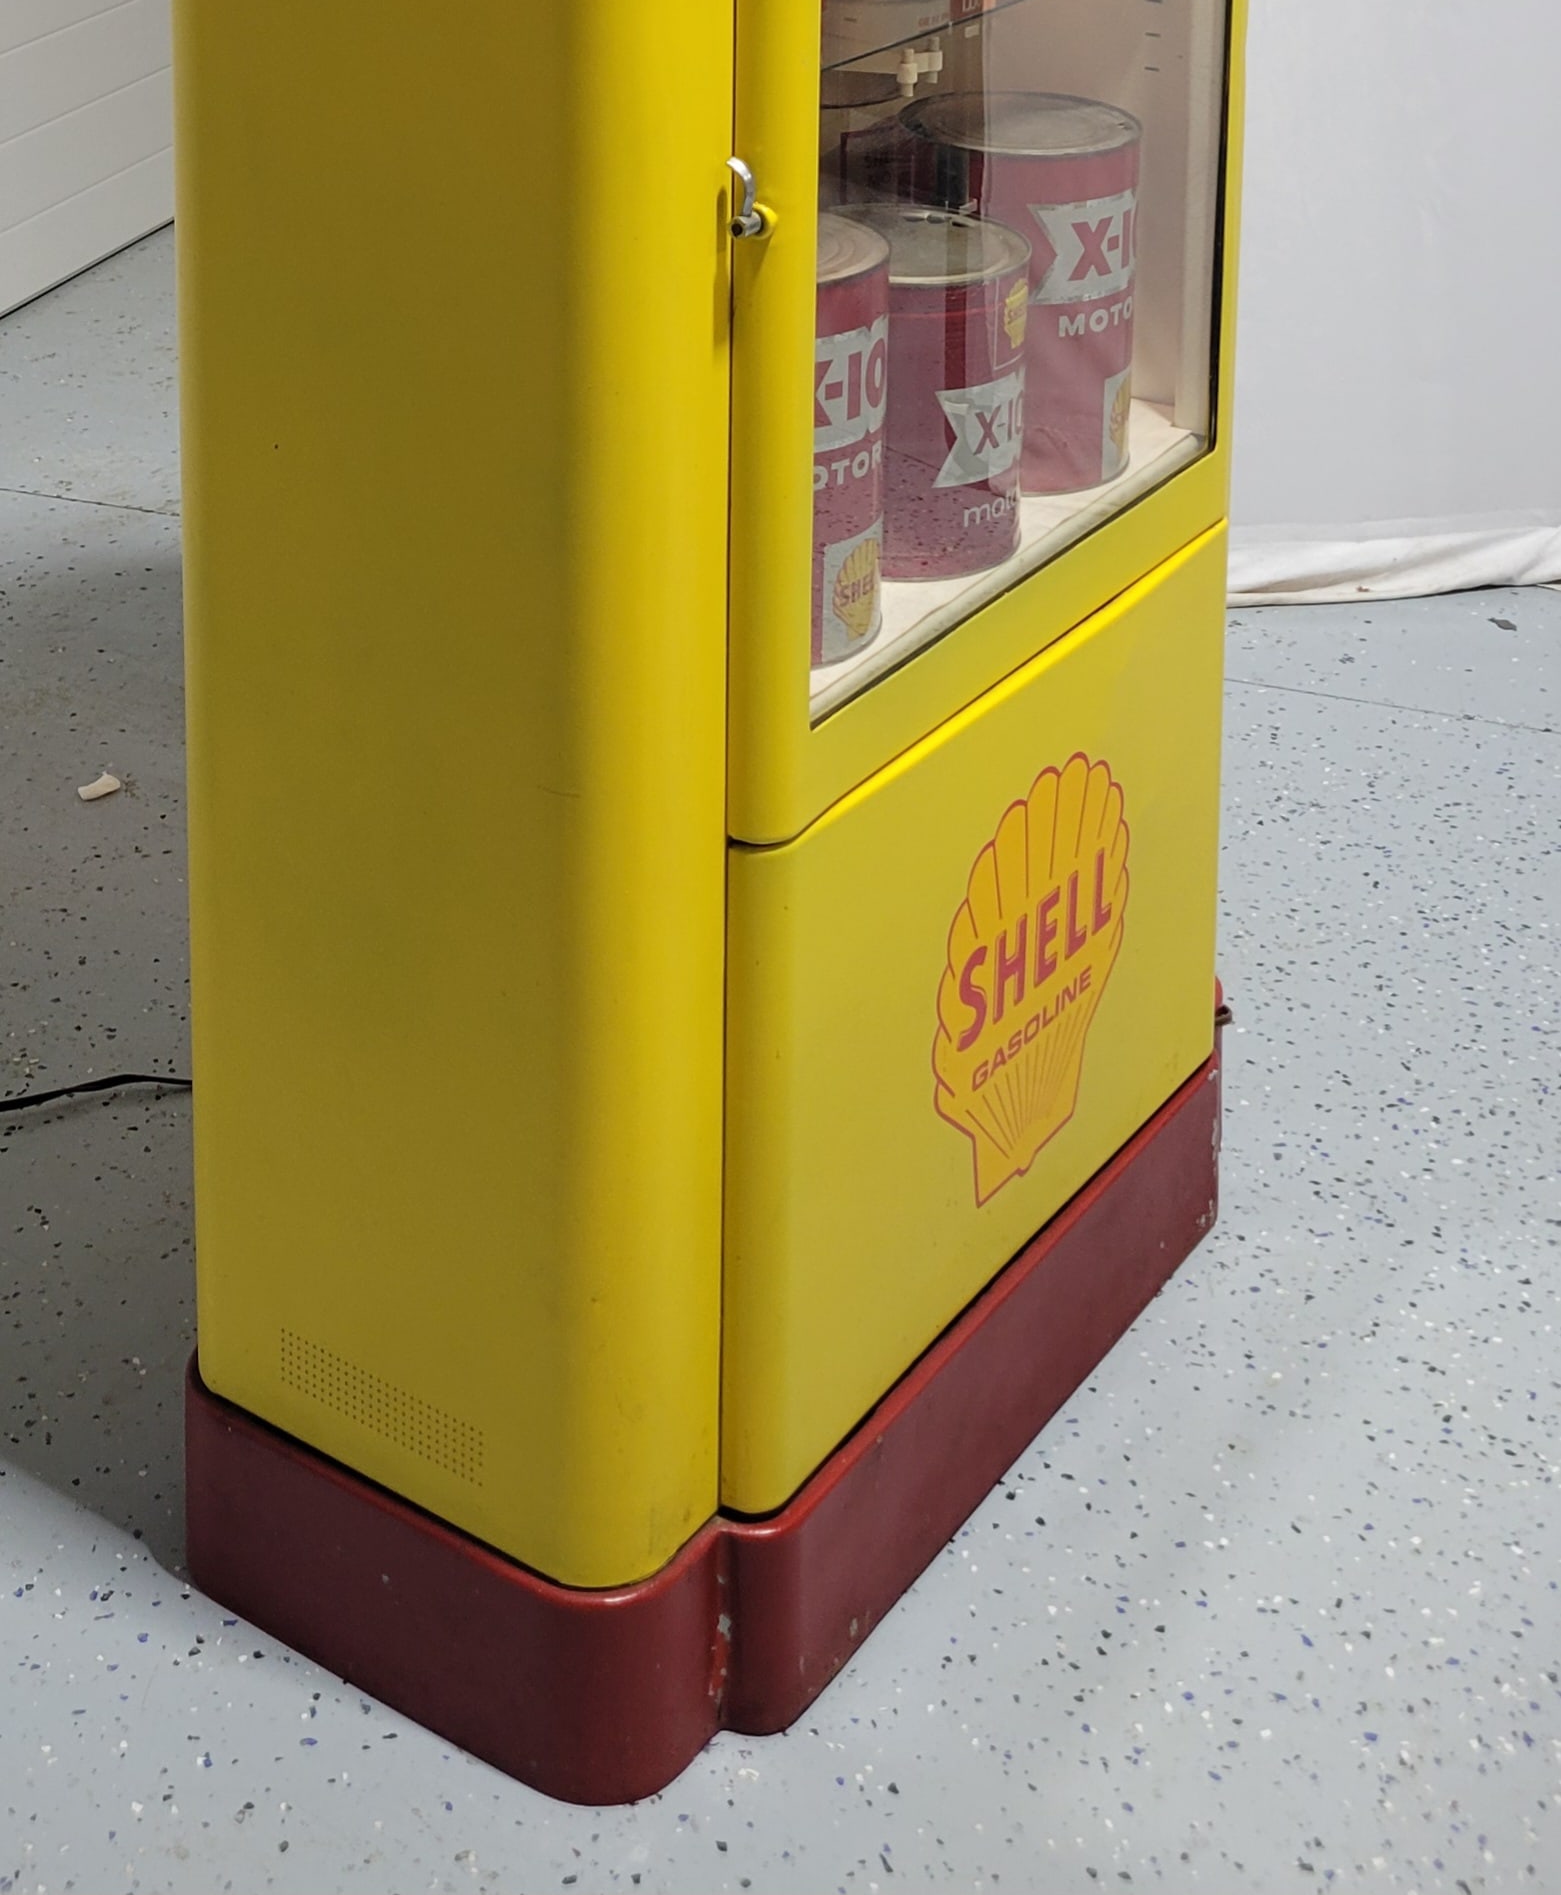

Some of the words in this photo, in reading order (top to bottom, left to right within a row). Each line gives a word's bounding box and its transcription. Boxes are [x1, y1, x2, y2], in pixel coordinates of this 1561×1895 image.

[1067, 208, 1136, 281] X-1
[1058, 295, 1133, 337] MOTO
[956, 846, 1113, 1052] SHELL
[971, 965, 1092, 1092] GASOLINE
